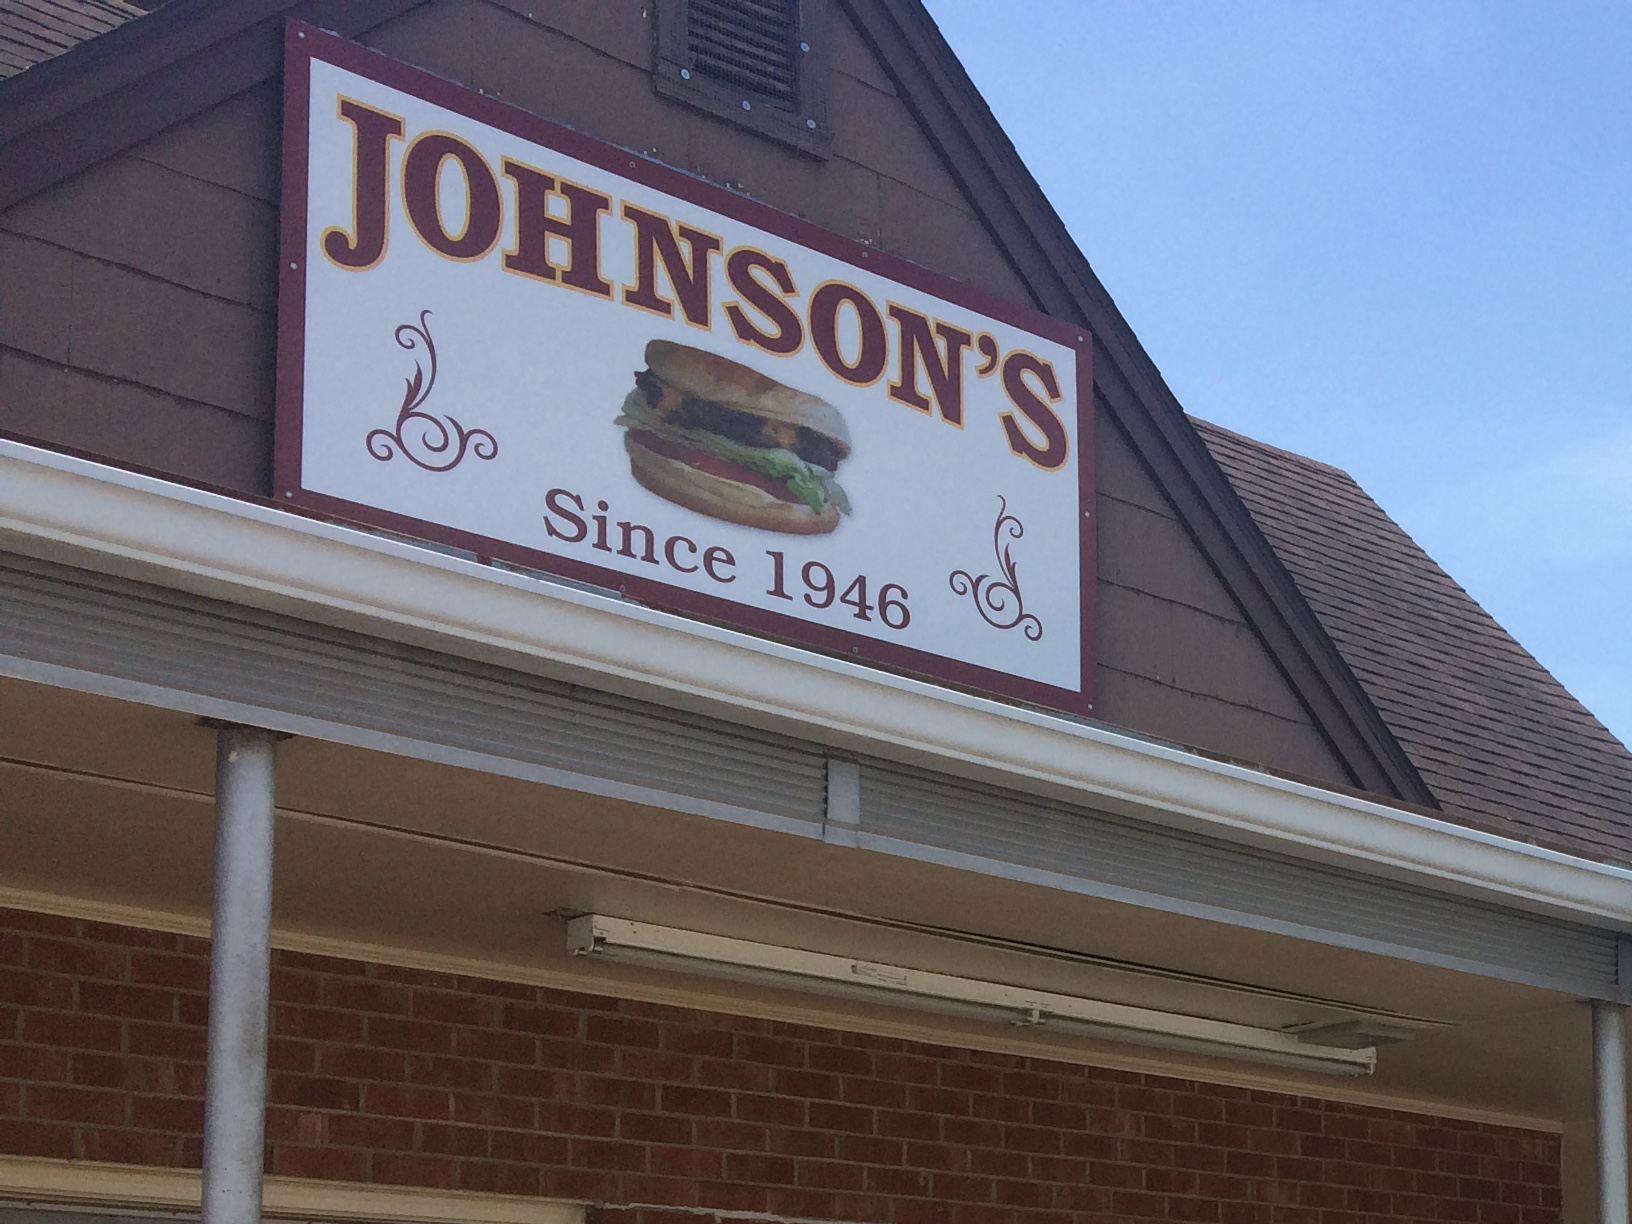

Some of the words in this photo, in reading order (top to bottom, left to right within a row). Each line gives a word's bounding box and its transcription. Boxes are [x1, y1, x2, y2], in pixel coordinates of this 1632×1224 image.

[319, 94, 1069, 472] JOHNSON'S
[542, 488, 737, 584] Since
[765, 550, 912, 630] 1946
